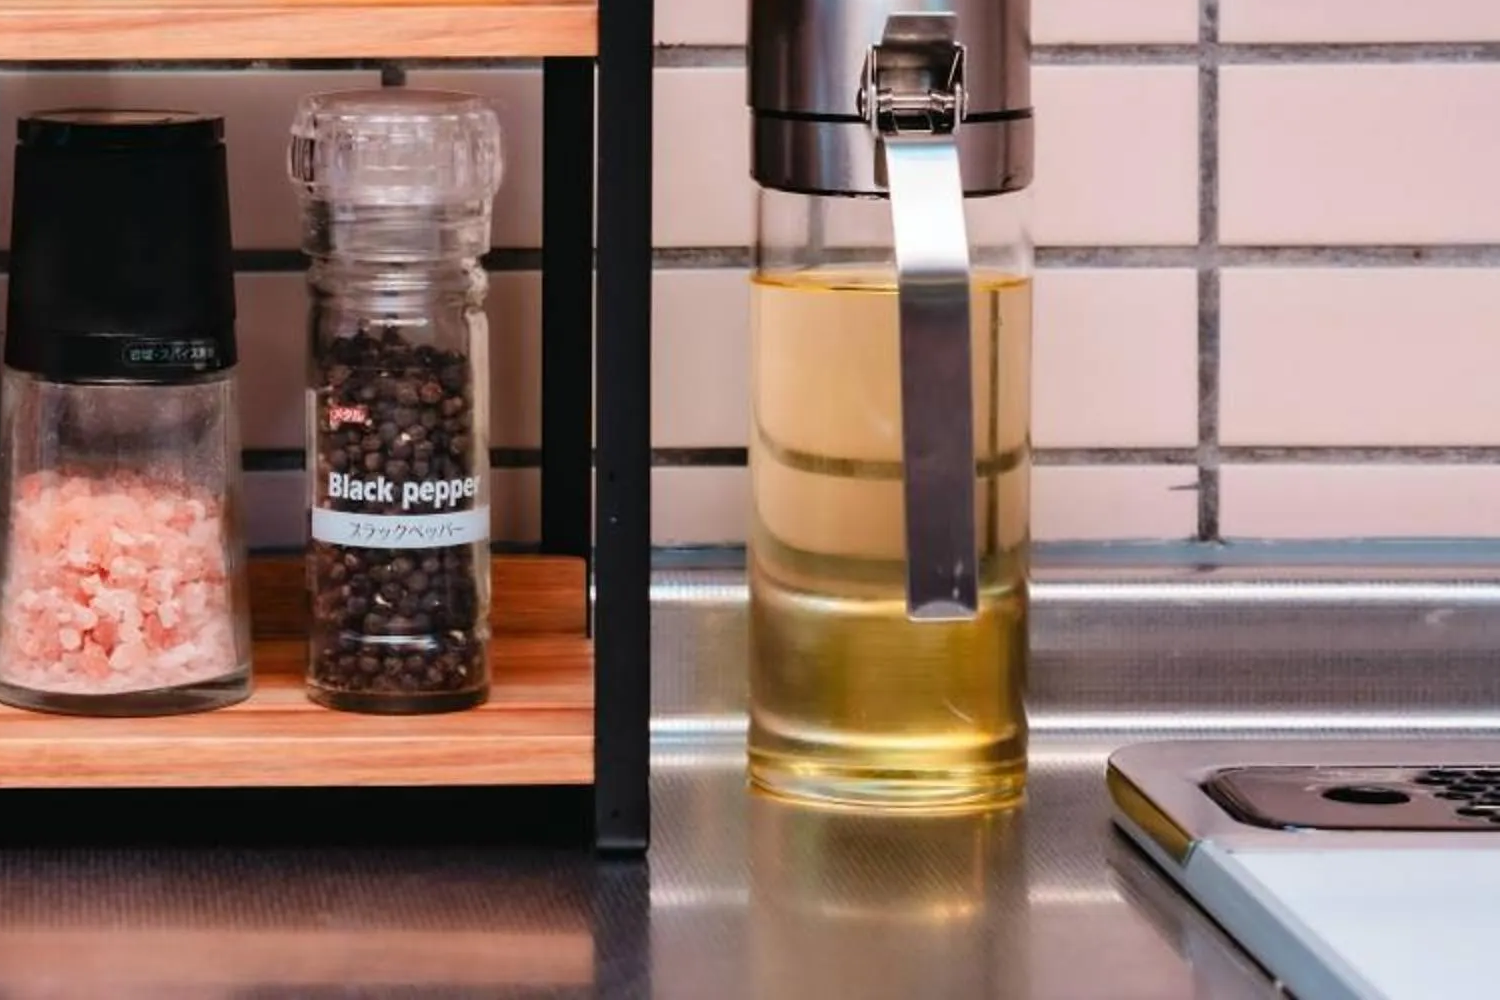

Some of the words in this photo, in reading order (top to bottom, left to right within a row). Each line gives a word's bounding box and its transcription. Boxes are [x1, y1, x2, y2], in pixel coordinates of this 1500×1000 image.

[328, 471, 394, 503] Black
[401, 474, 481, 511] pepper
[350, 520, 464, 541] ブラックペッパー
